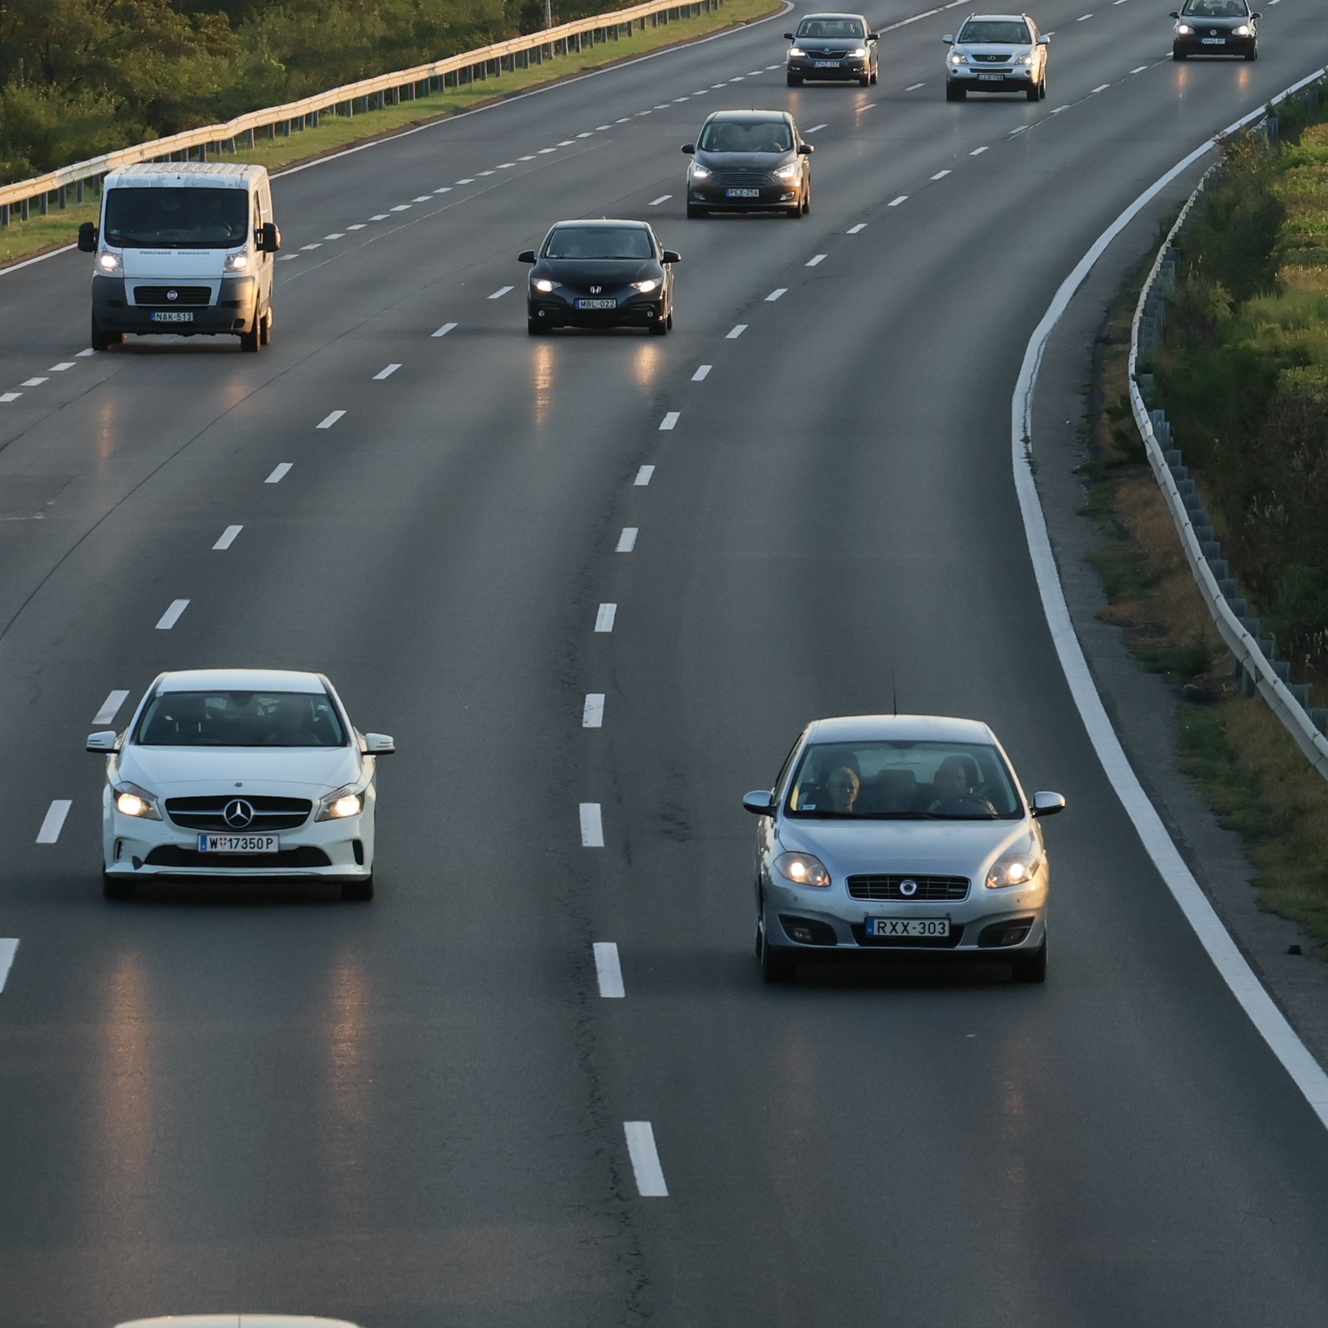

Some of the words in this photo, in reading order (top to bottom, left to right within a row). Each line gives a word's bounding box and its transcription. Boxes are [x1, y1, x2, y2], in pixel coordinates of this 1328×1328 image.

[580, 300, 615, 308] MBL-022
[156, 313, 192, 321] NAK-513
[209, 838, 217, 850] W
[877, 922, 947, 935] RXX-303
